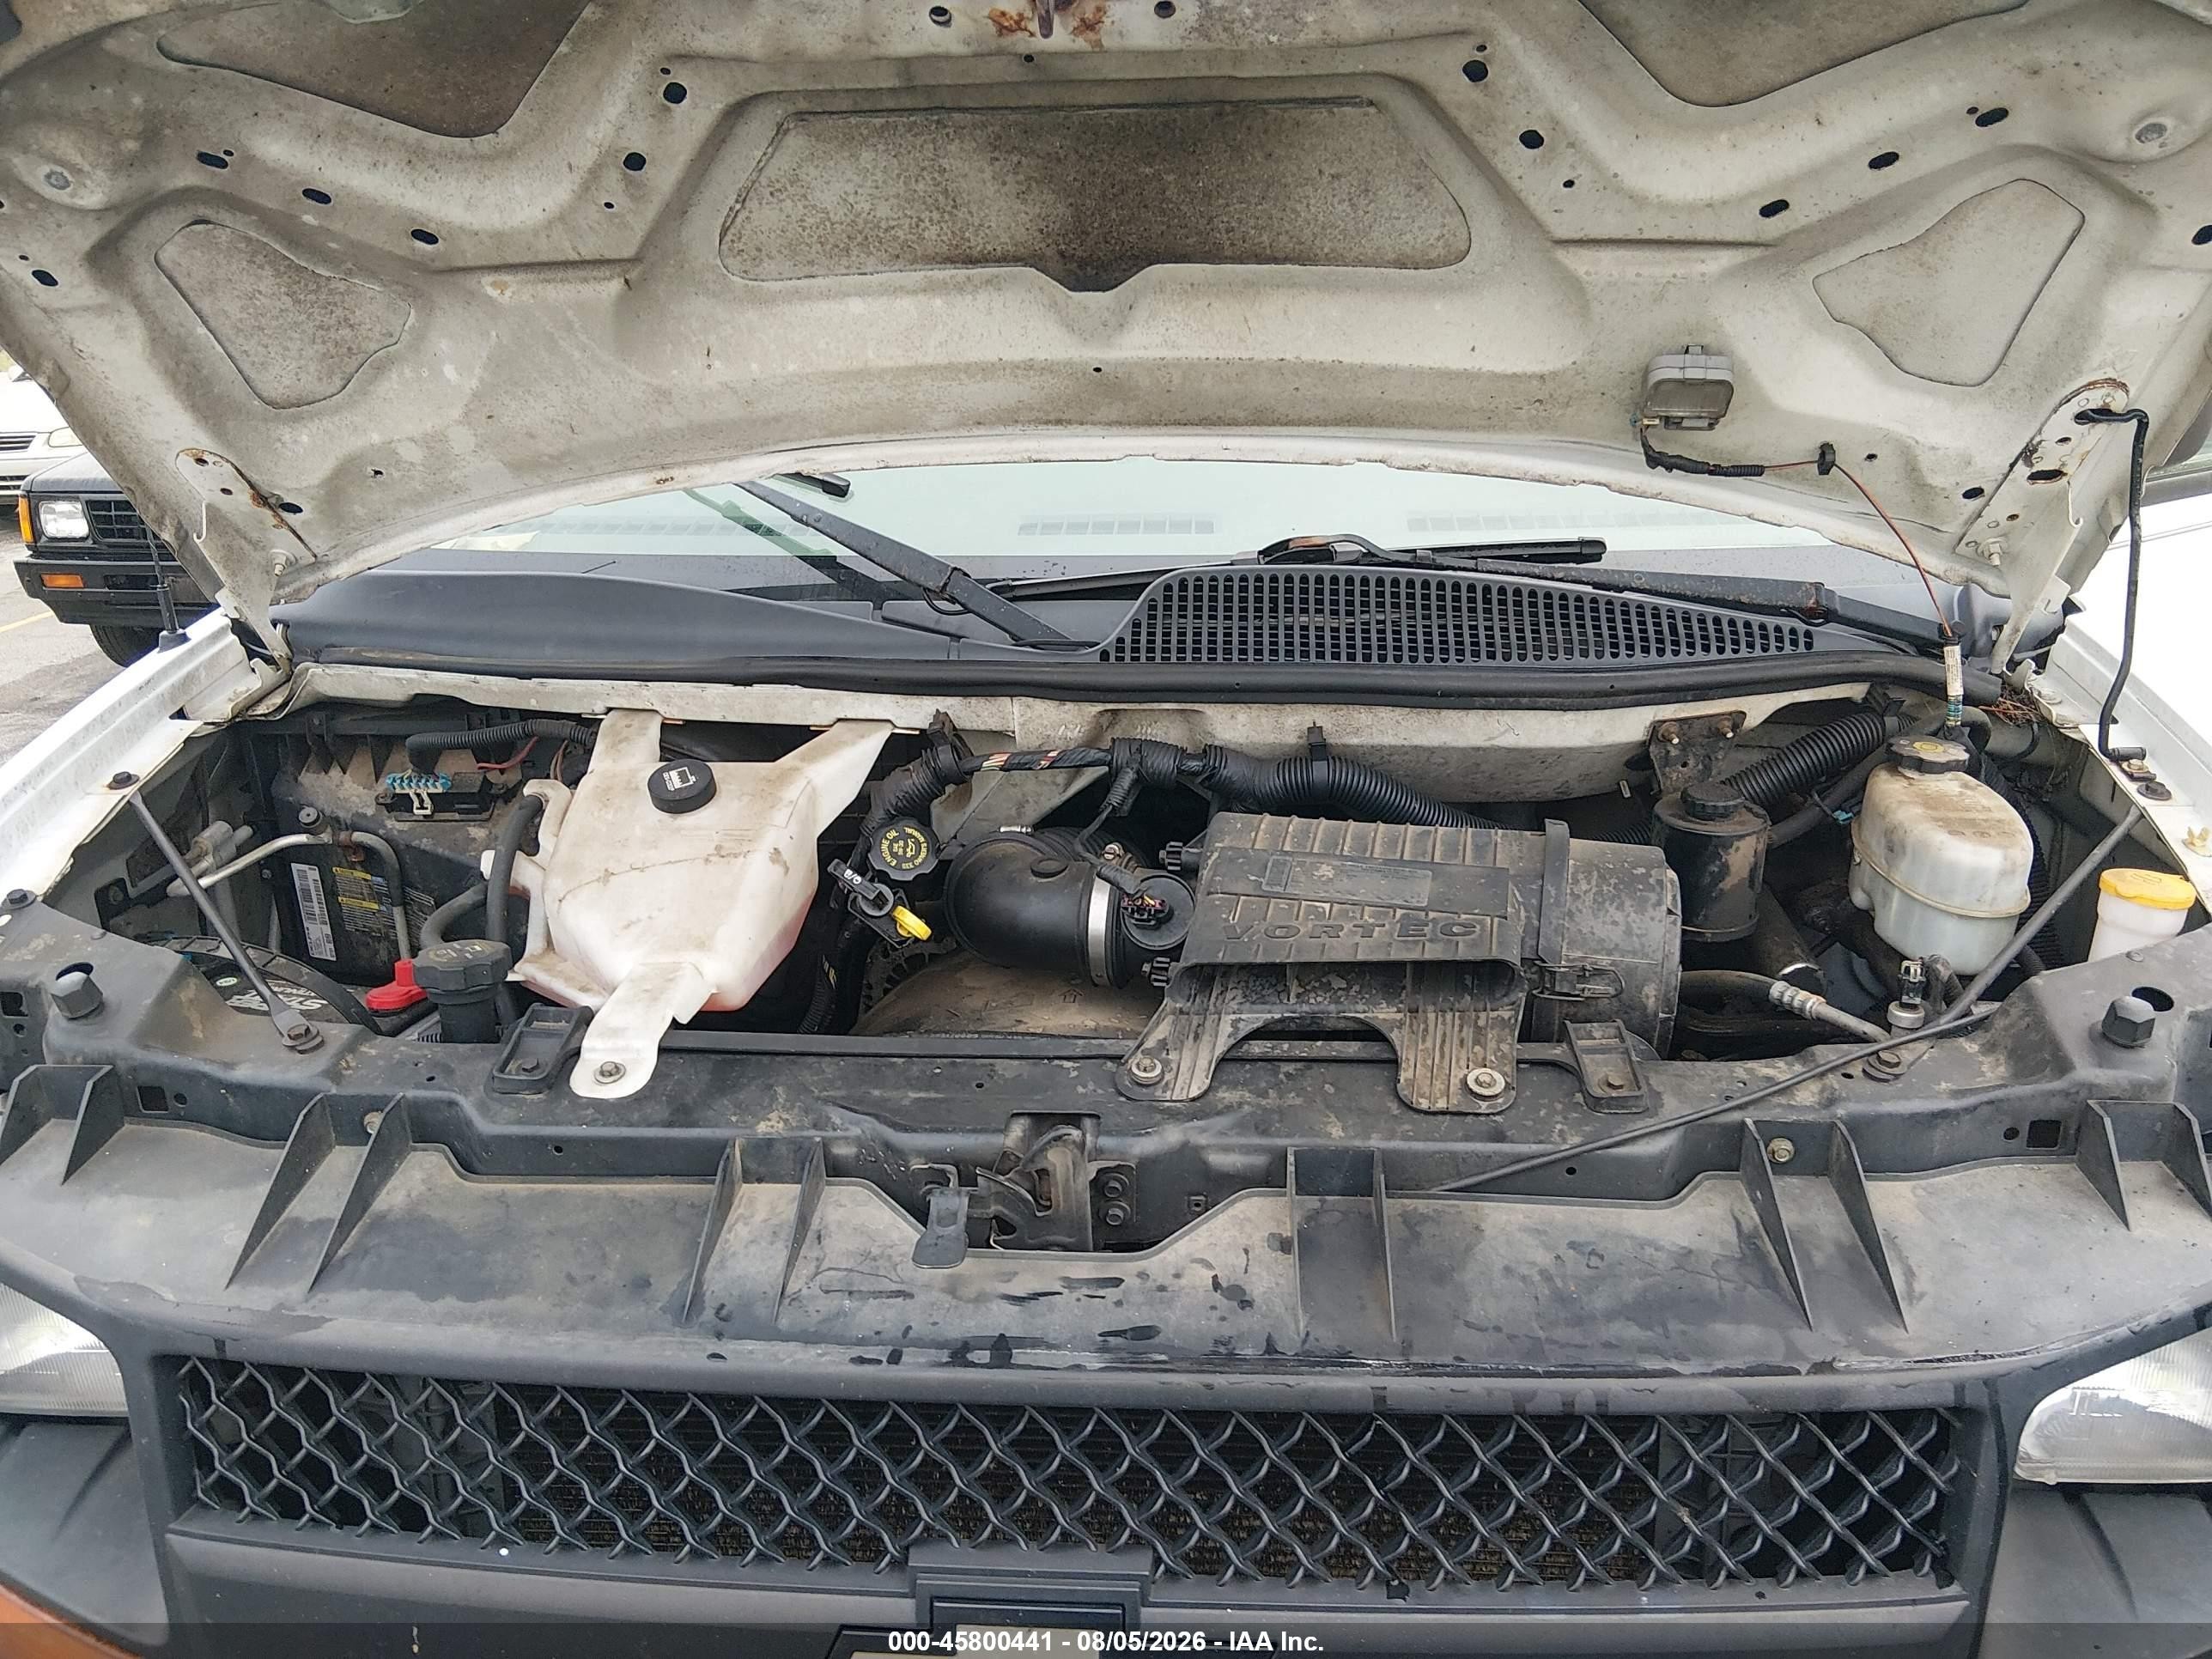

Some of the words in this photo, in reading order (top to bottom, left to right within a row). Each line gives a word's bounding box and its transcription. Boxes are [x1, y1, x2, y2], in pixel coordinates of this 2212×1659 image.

[885, 829, 900, 840] OIL
[880, 837, 898, 866] ENGINE
[1223, 921, 1478, 940] VORTEC
